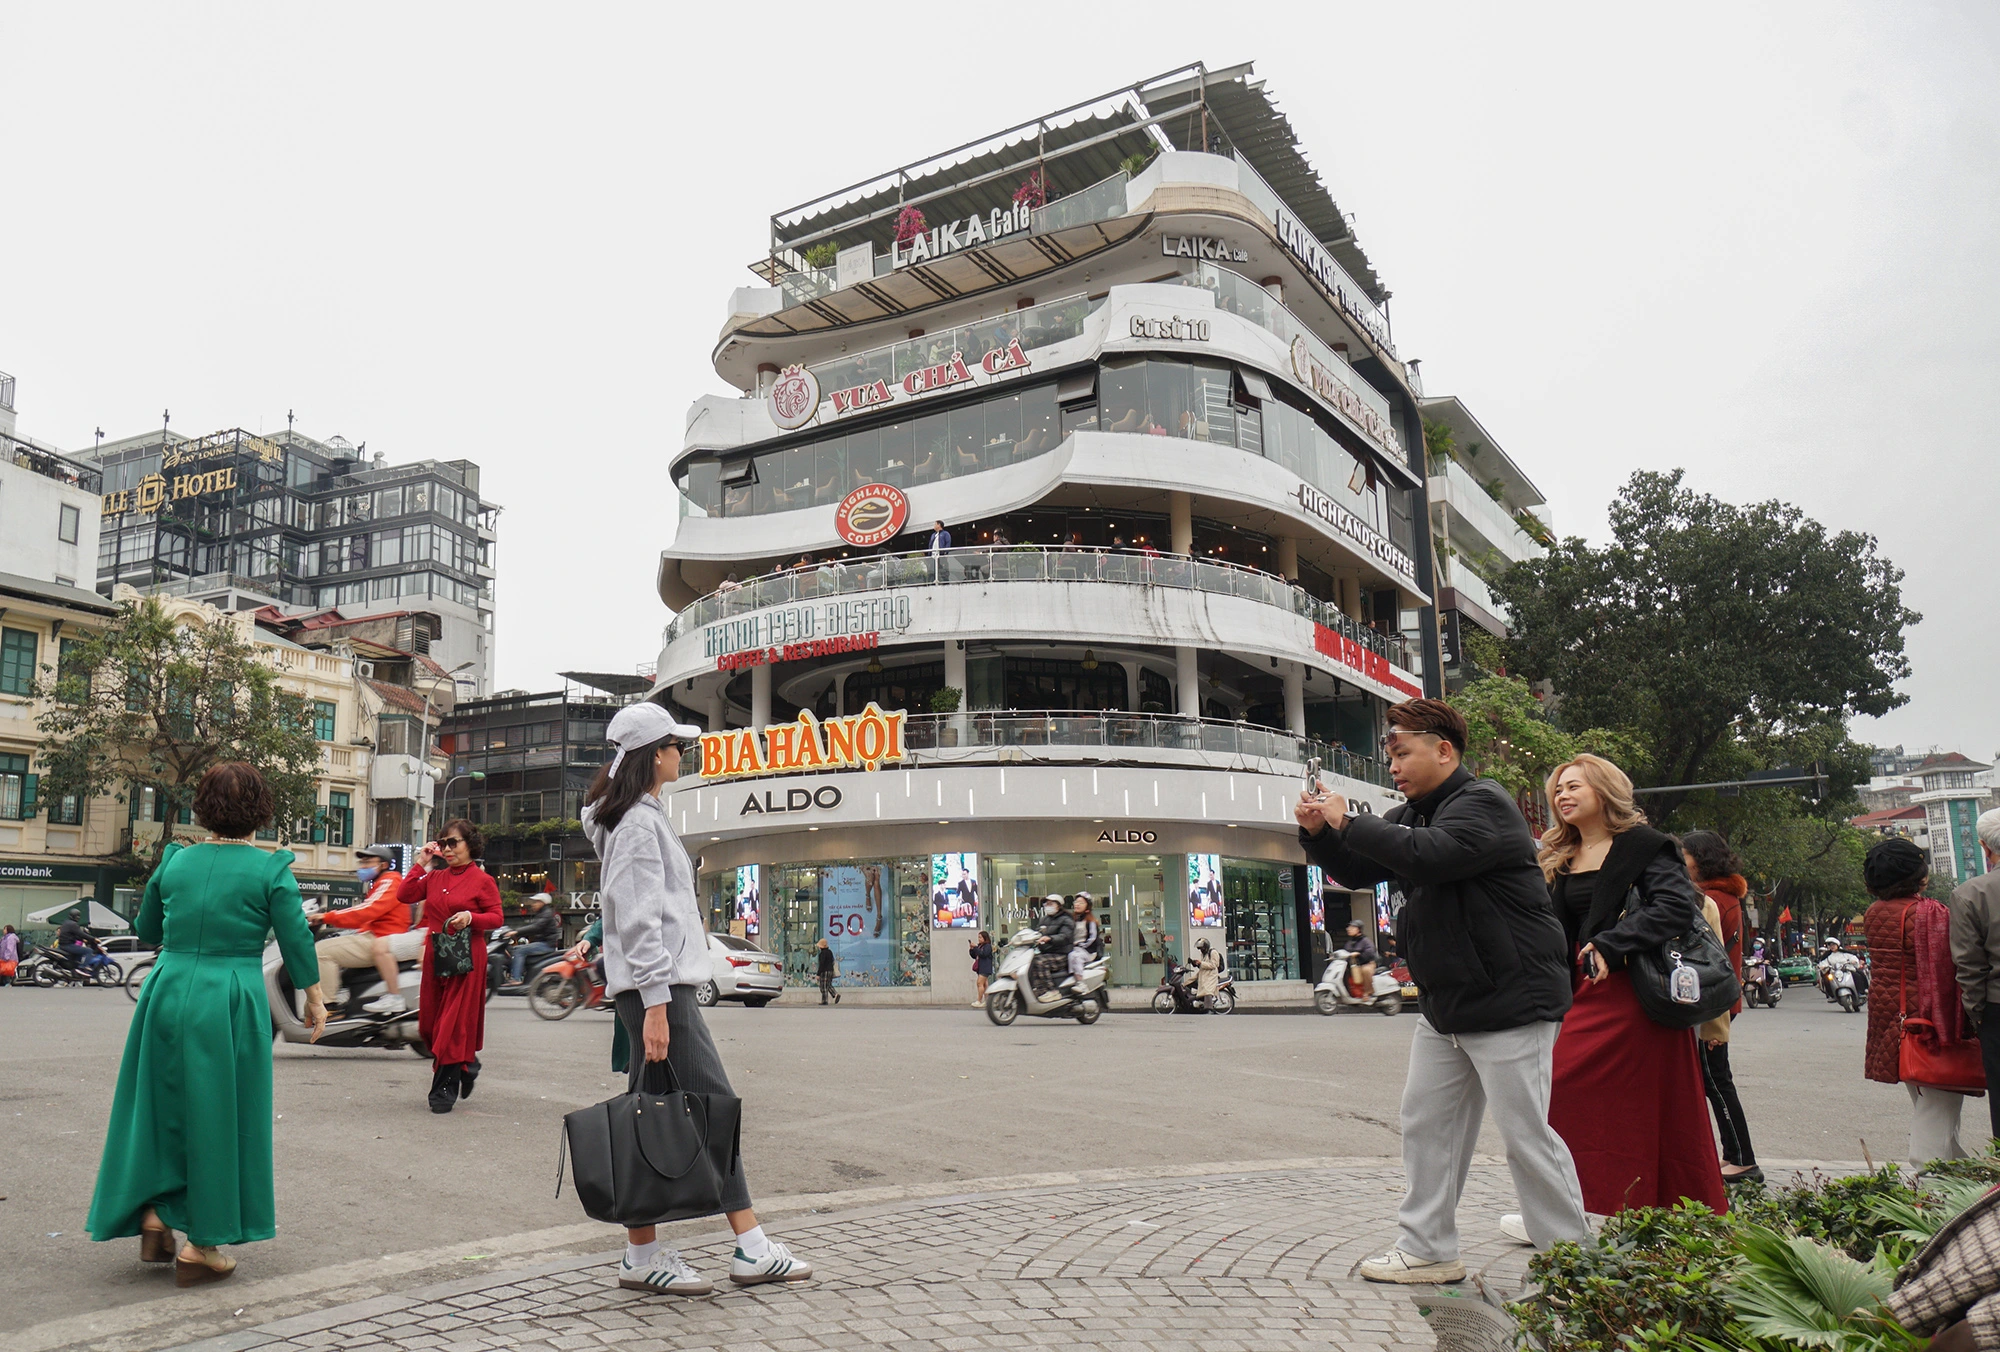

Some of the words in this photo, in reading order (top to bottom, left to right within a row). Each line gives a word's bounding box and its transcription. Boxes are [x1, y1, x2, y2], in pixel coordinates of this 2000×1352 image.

[891, 213, 987, 270] LAIKA
[990, 199, 1031, 238] Café
[1161, 232, 1230, 260] LAIKA
[1276, 208, 1323, 282] LAIKA
[1187, 318, 1211, 341] 10
[828, 378, 894, 414] VUA
[902, 350, 975, 396] CHẢ
[981, 336, 1033, 375] CÁ
[180, 453, 198, 465] SKY
[199, 444, 235, 460] LOUNGE
[172, 467, 237, 500] HOTEL
[839, 486, 903, 518] HIGHLANDS
[847, 523, 896, 543] COFFEE
[1300, 483, 1377, 554] HIGHLANDS
[1376, 538, 1416, 580] COFFEE
[704, 616, 759, 658] HANOI
[764, 605, 815, 645] 1930
[824, 595, 911, 637] BISTRO
[717, 648, 766, 672] COFFEE
[767, 647, 780, 664] &
[783, 631, 880, 662] RESTAURANT
[700, 730, 763, 779] BIA
[764, 711, 825, 771] HÀ
[825, 704, 904, 773] NỘI
[739, 785, 843, 816] ALDO
[1097, 829, 1158, 844] ALDO
[829, 913, 864, 937] 50
